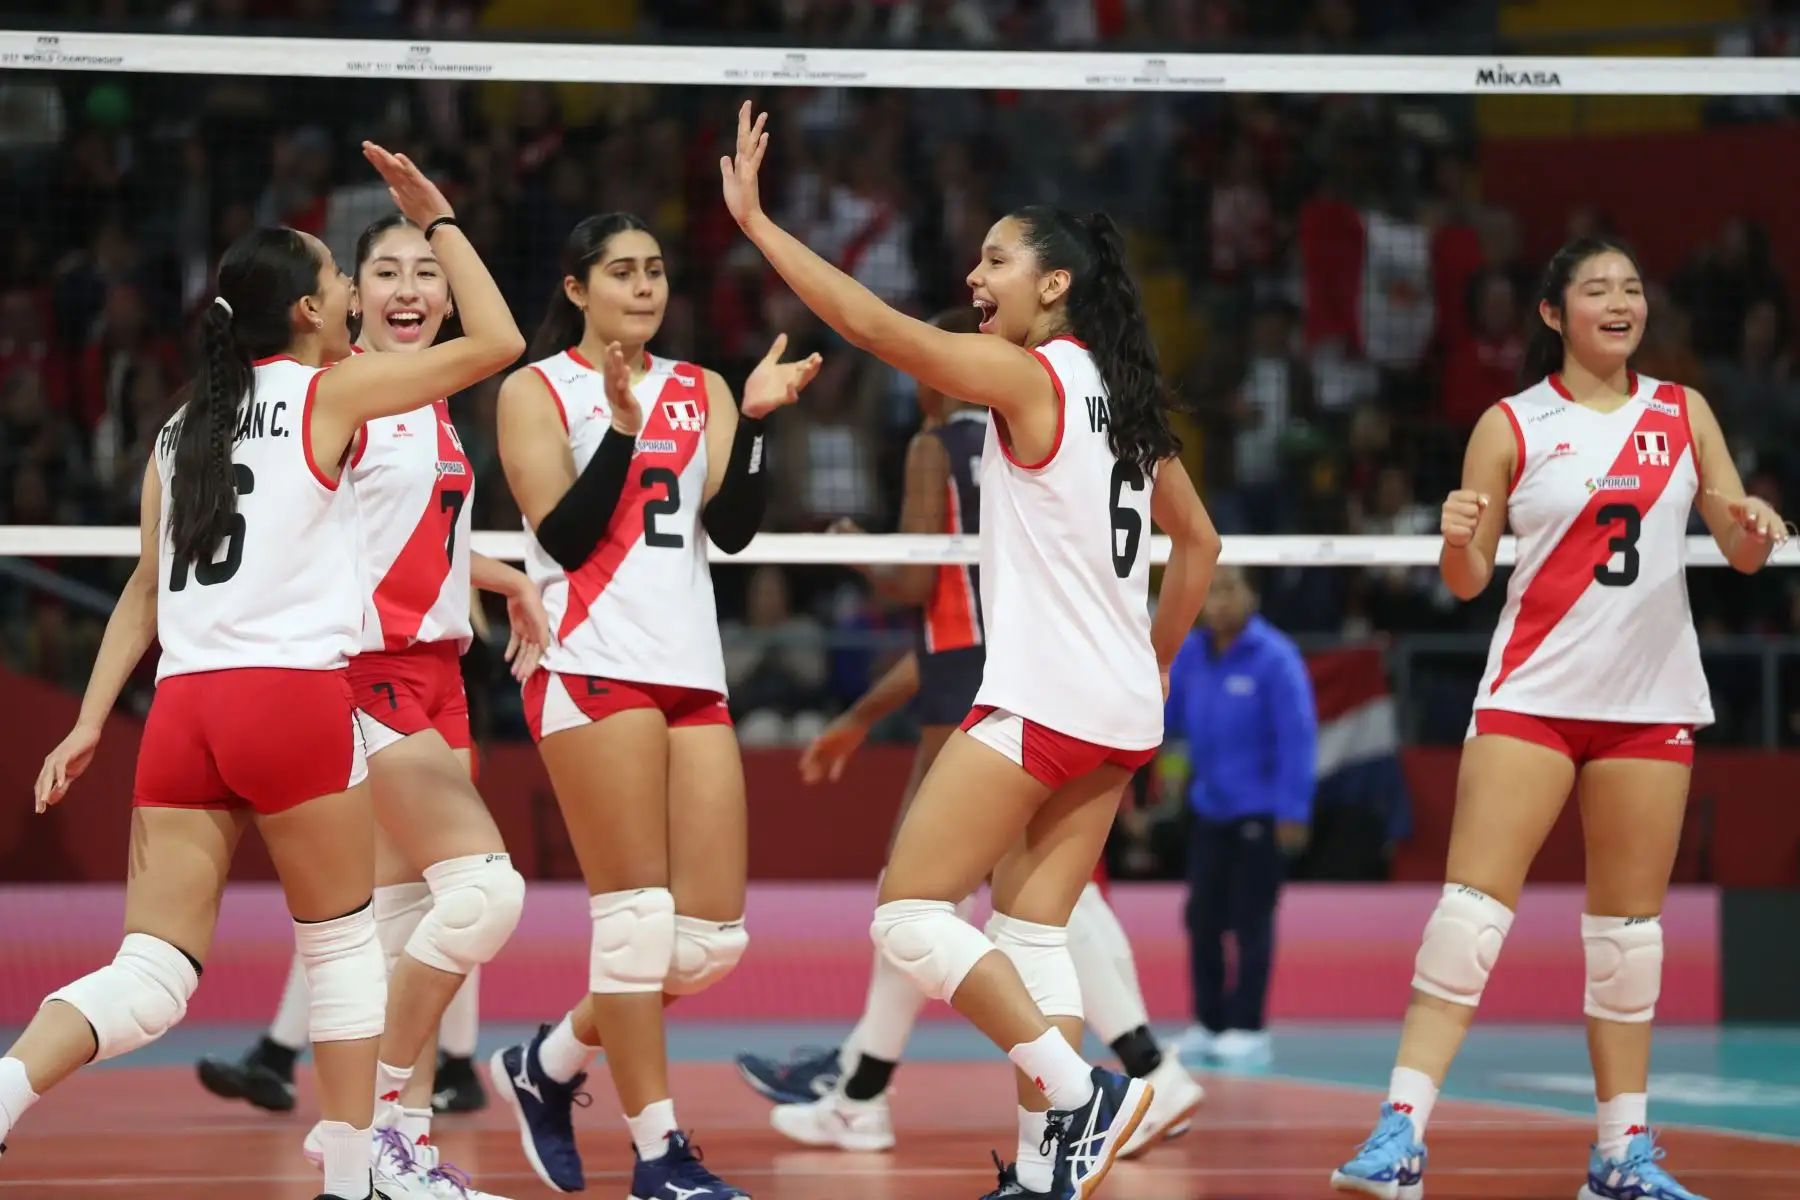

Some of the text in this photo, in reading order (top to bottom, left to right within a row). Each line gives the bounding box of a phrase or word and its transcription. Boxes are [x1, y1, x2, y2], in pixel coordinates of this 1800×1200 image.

[271, 401, 289, 438] C.
[441, 489, 465, 569] 7
[640, 467, 684, 548] 2
[1109, 458, 1144, 578] 6
[1593, 503, 1641, 586] 3
[372, 682, 397, 710] 7
